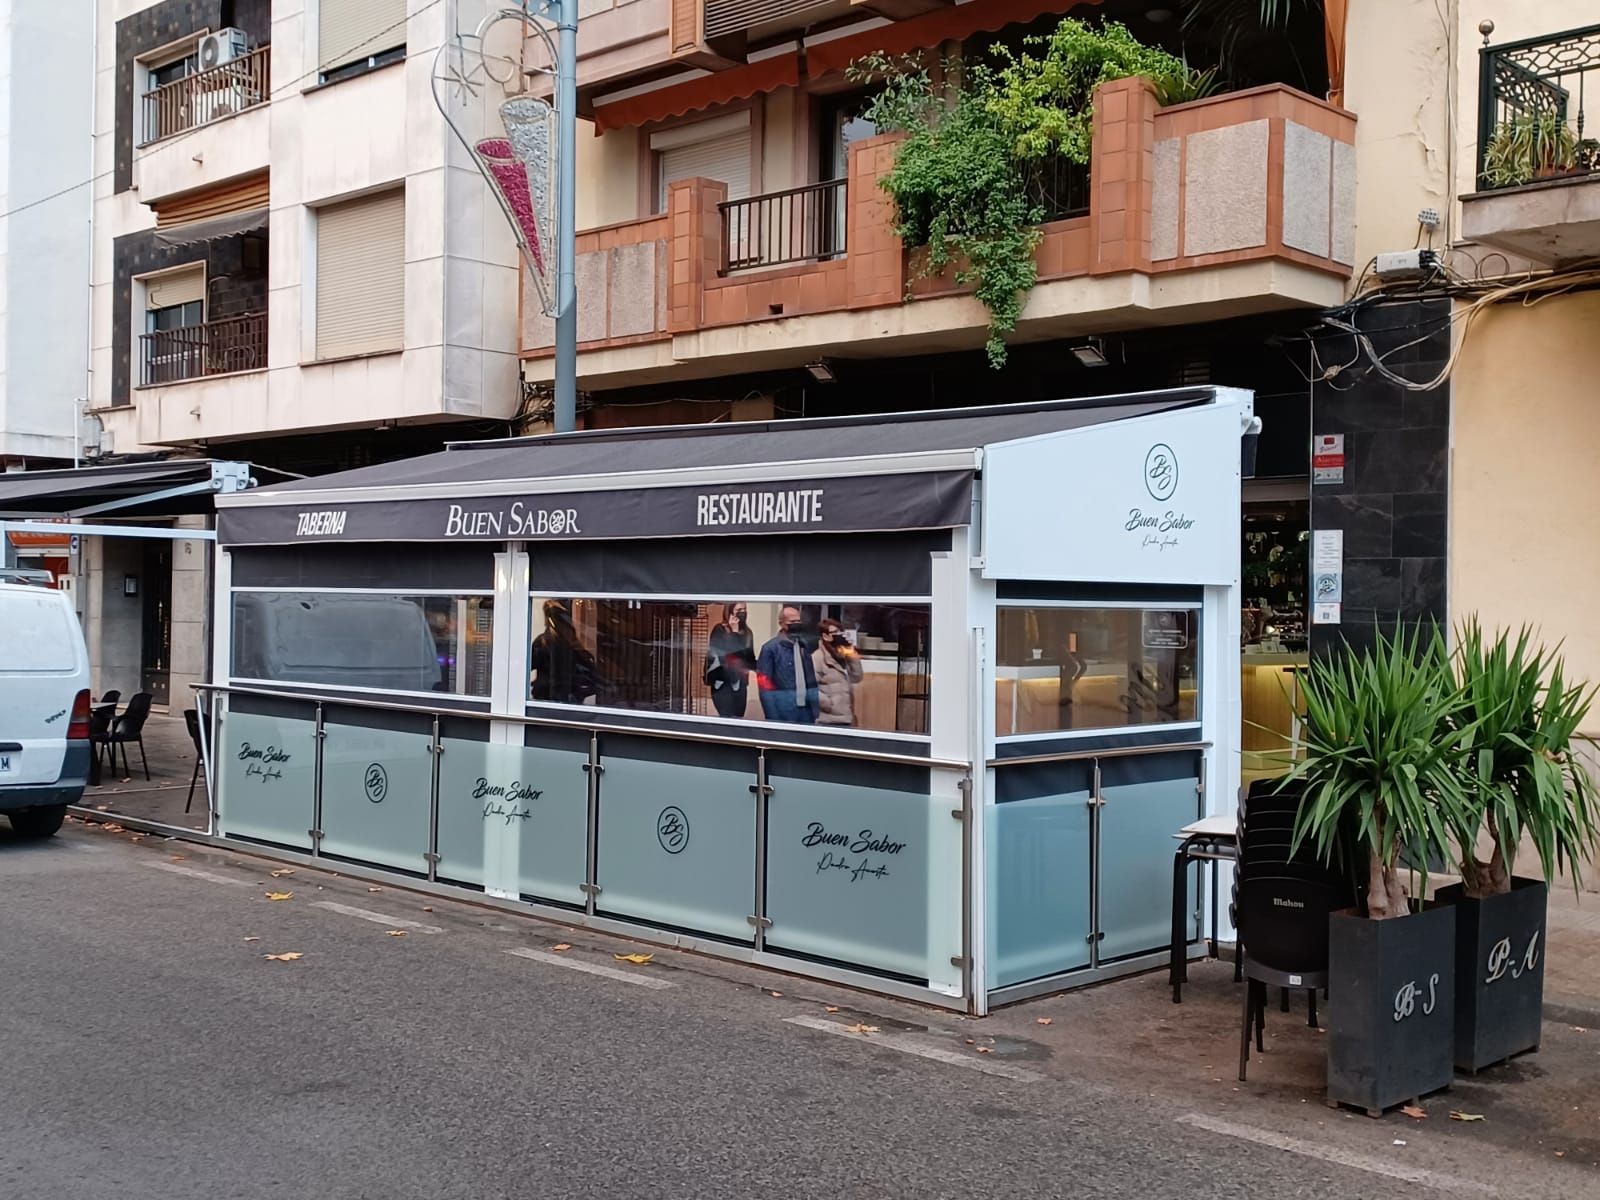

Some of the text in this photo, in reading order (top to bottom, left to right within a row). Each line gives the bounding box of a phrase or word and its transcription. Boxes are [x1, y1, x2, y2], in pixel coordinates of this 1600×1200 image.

[444, 504, 503, 536] BUEN
[697, 489, 823, 526] RESTAURANTE
[1125, 508, 1195, 532] Buen Sabor
[296, 511, 347, 536] TABERNA
[238, 742, 291, 764] Buen Sabor
[472, 777, 543, 801] Buen Sabor
[801, 822, 907, 854] Buen Sabor
